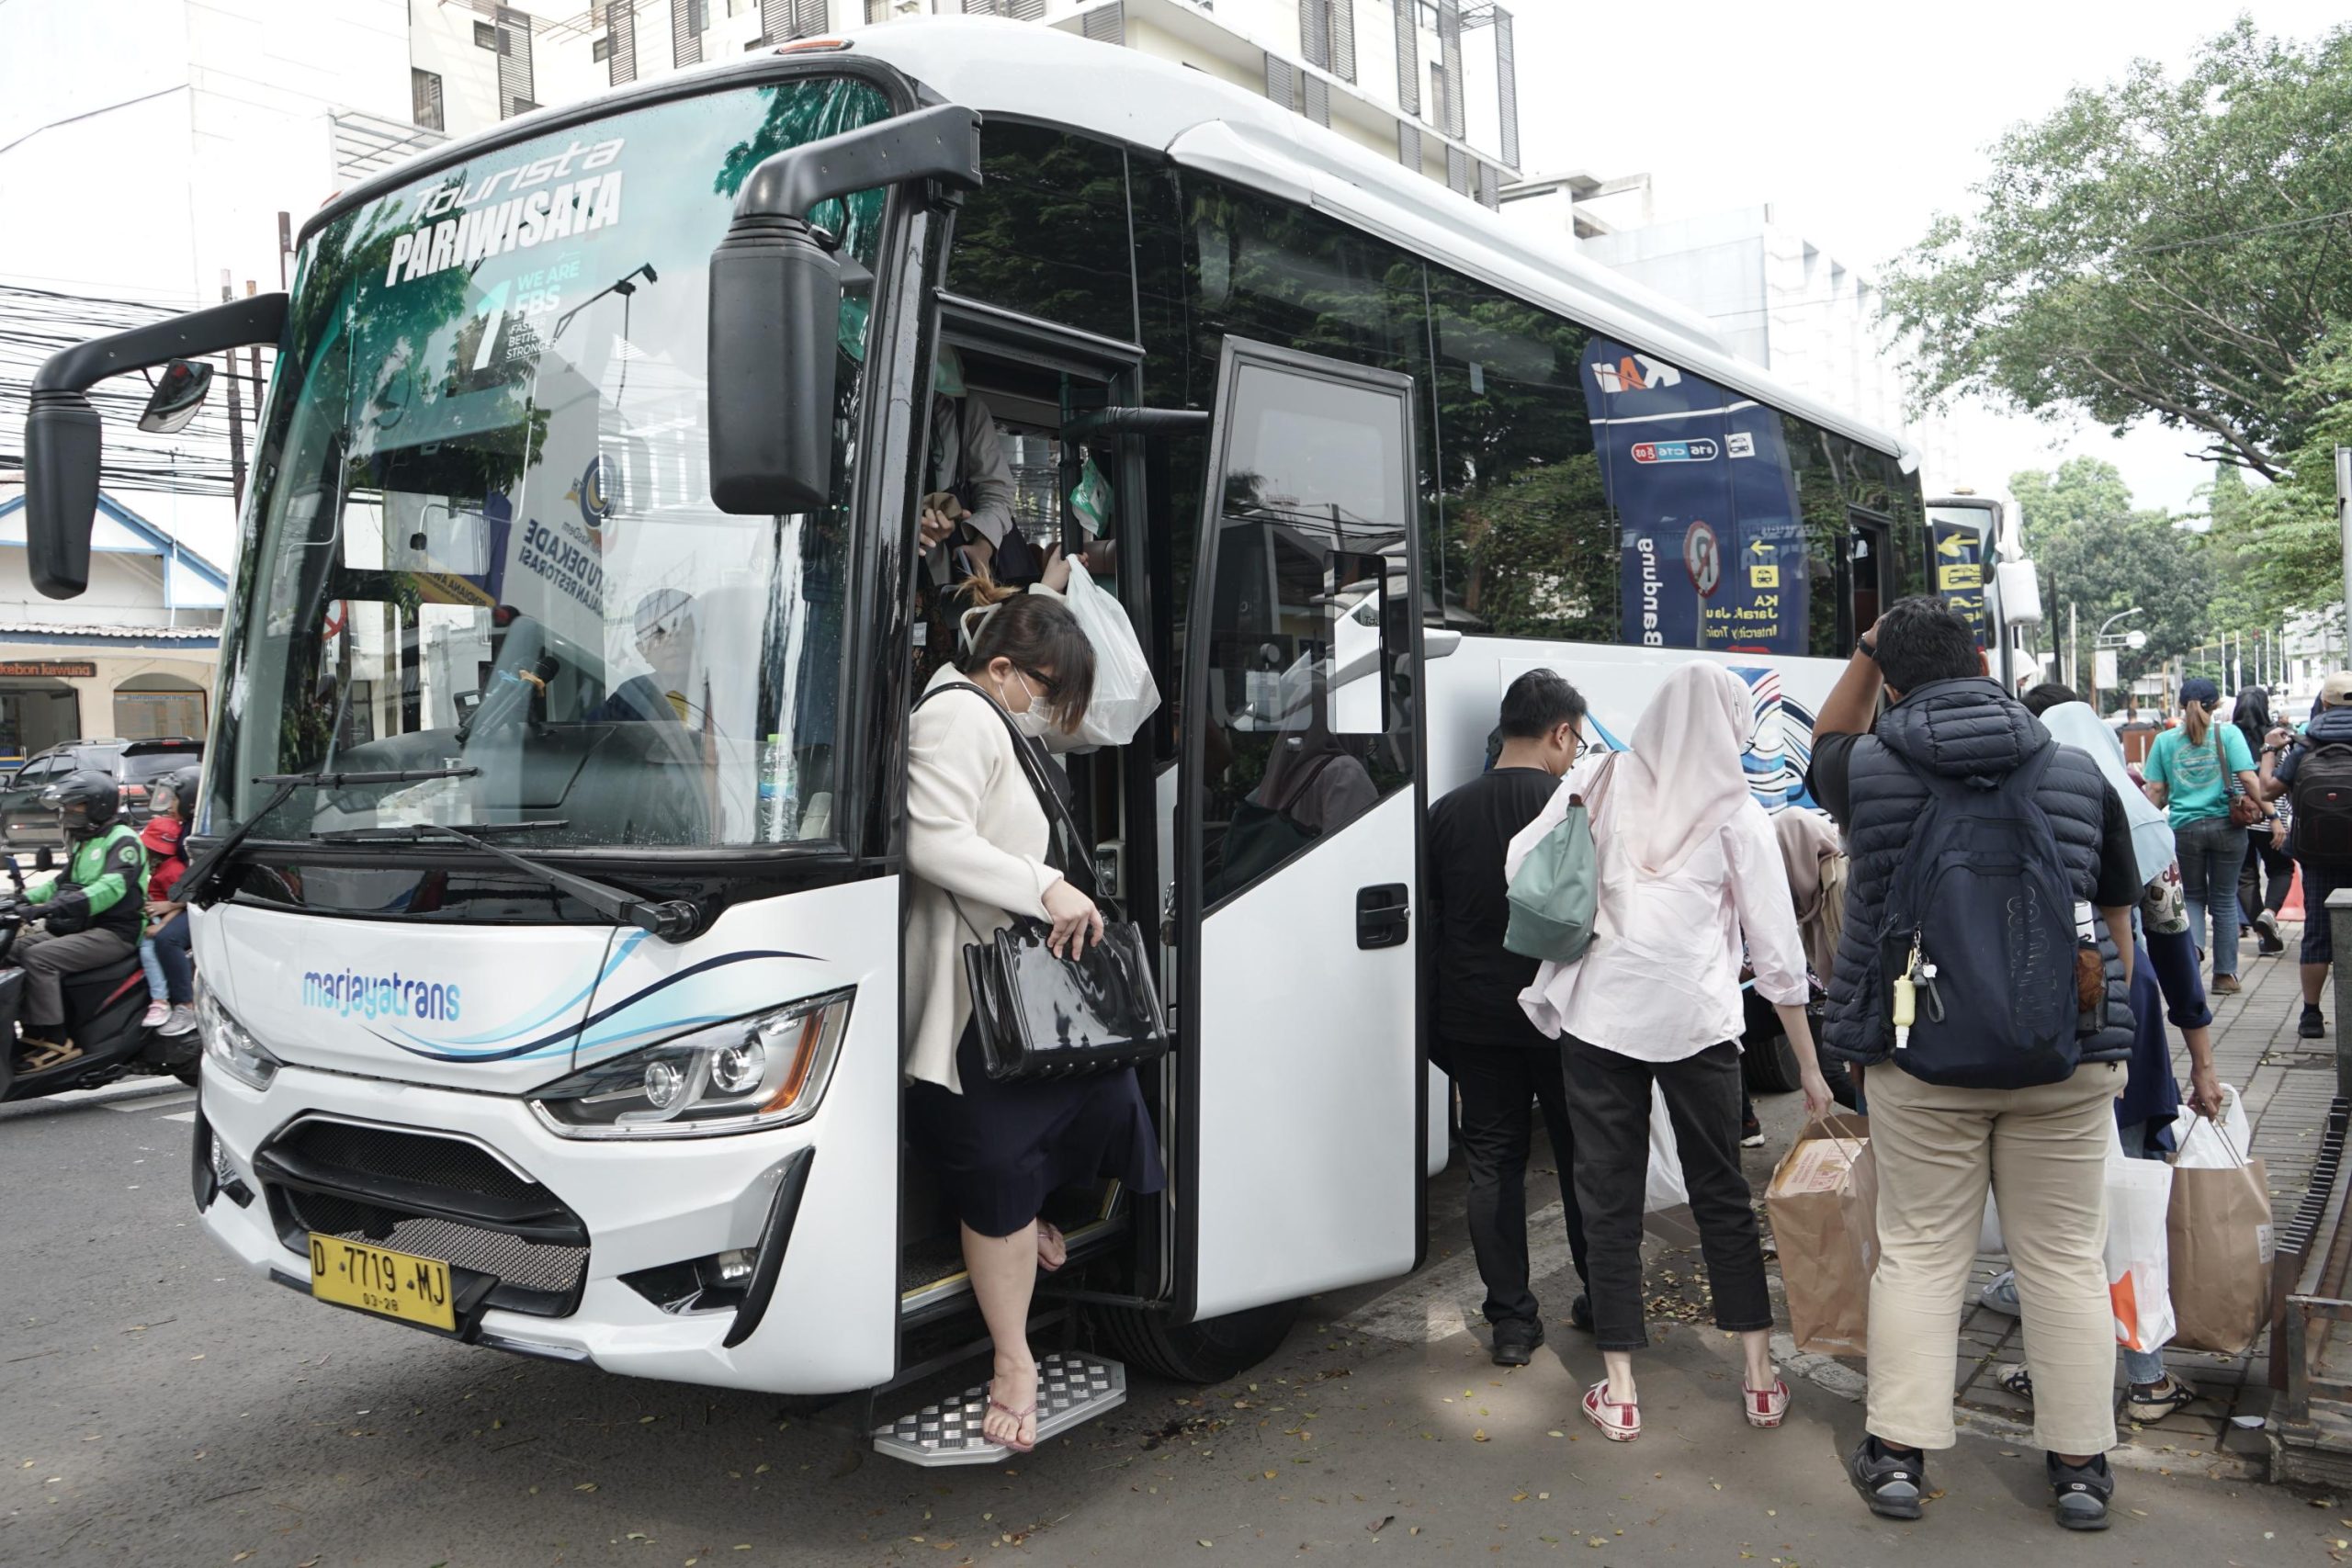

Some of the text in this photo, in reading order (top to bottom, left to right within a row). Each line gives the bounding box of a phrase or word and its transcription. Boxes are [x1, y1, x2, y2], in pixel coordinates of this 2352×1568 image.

[385, 170, 623, 288] PARIWISATA
[517, 260, 581, 291] WE ARE
[514, 285, 560, 321] FBS
[508, 329, 546, 347] BETTER
[509, 317, 546, 335] FASTER
[506, 337, 559, 360] STRONGER
[303, 967, 460, 1021] marjayatrans
[312, 1240, 445, 1304] D 7719 MJ
